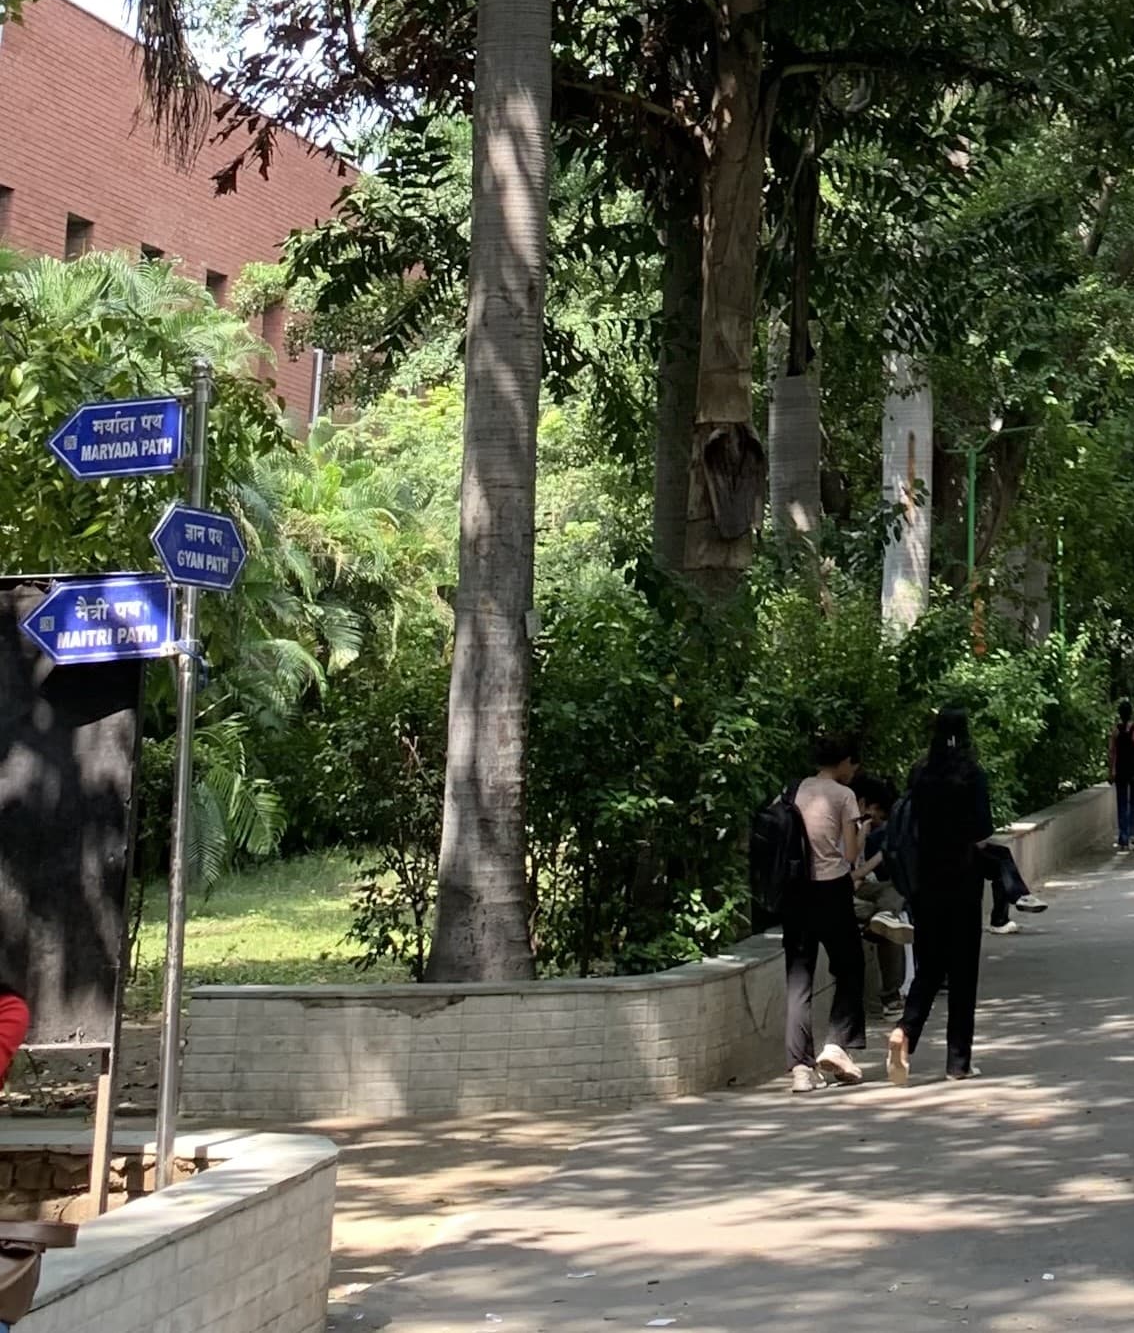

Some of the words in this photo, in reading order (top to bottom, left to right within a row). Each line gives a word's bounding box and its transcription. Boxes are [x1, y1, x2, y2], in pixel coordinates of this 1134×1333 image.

[92, 411, 136, 435] मर्यादा
[141, 414, 164, 431] पथ
[81, 441, 138, 462] MARYADA
[141, 437, 172, 456] PATH
[208, 528, 223, 546] पथ
[177, 550, 205, 569] GYAN
[206, 554, 229, 574] PATH
[75, 596, 109, 621] मैत्री
[113, 601, 143, 618] पथ
[57, 628, 112, 649] MAITRI
[117, 625, 158, 644] PATH
